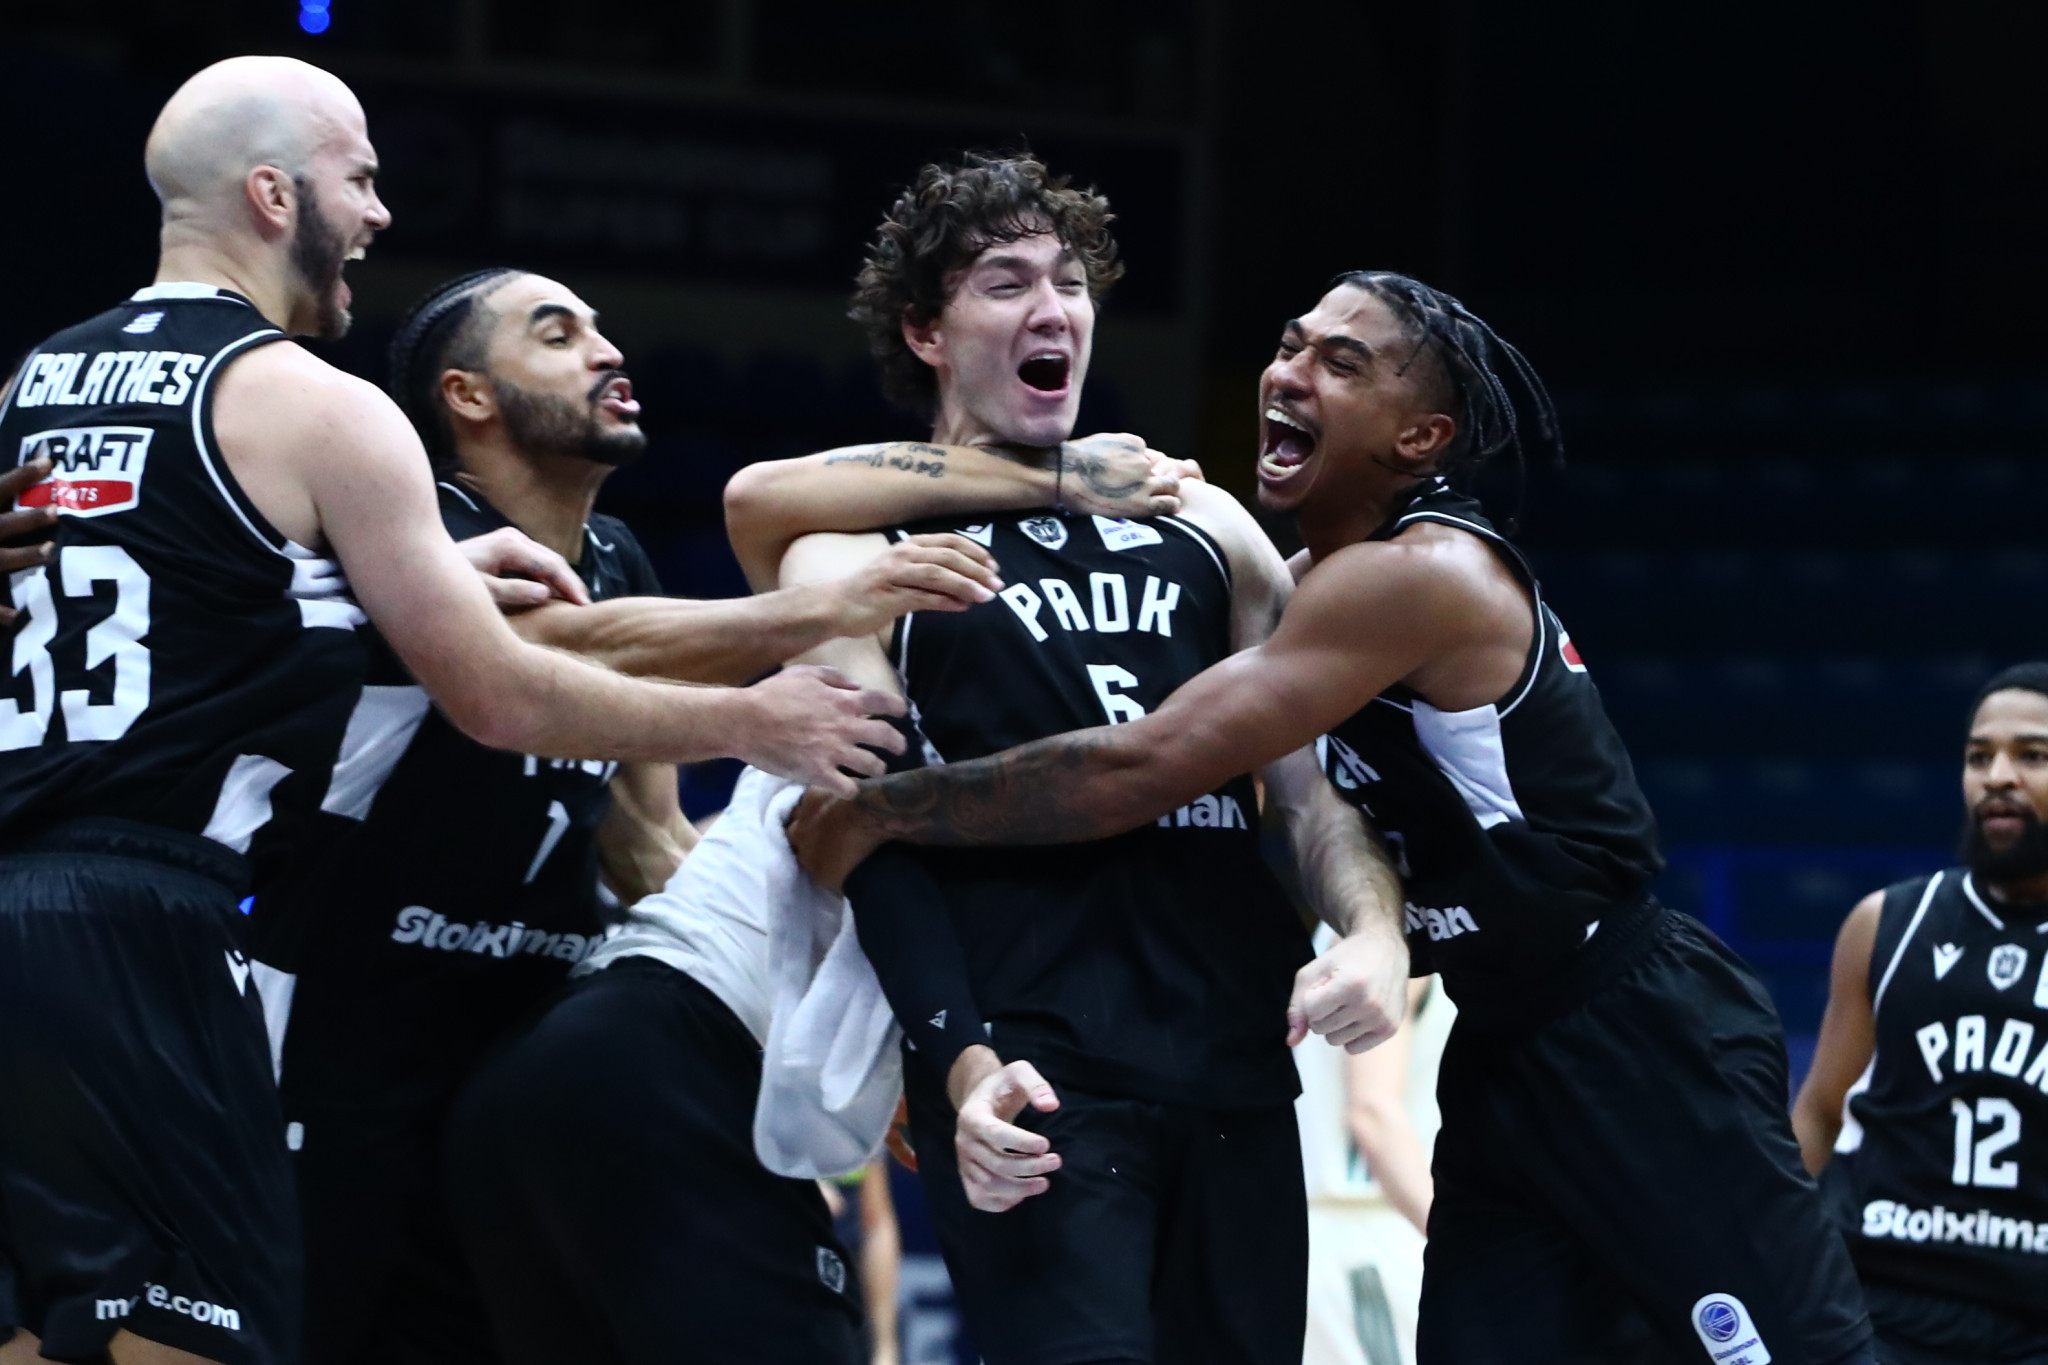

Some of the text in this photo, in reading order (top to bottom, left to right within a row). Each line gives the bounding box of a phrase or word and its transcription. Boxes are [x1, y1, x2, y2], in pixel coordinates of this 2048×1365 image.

[17, 351, 205, 407] CALATHES
[999, 572, 1181, 642] PAOK
[0, 546, 151, 751] 33
[1950, 1097, 2022, 1188] 12
[95, 1281, 240, 1331] me.com
